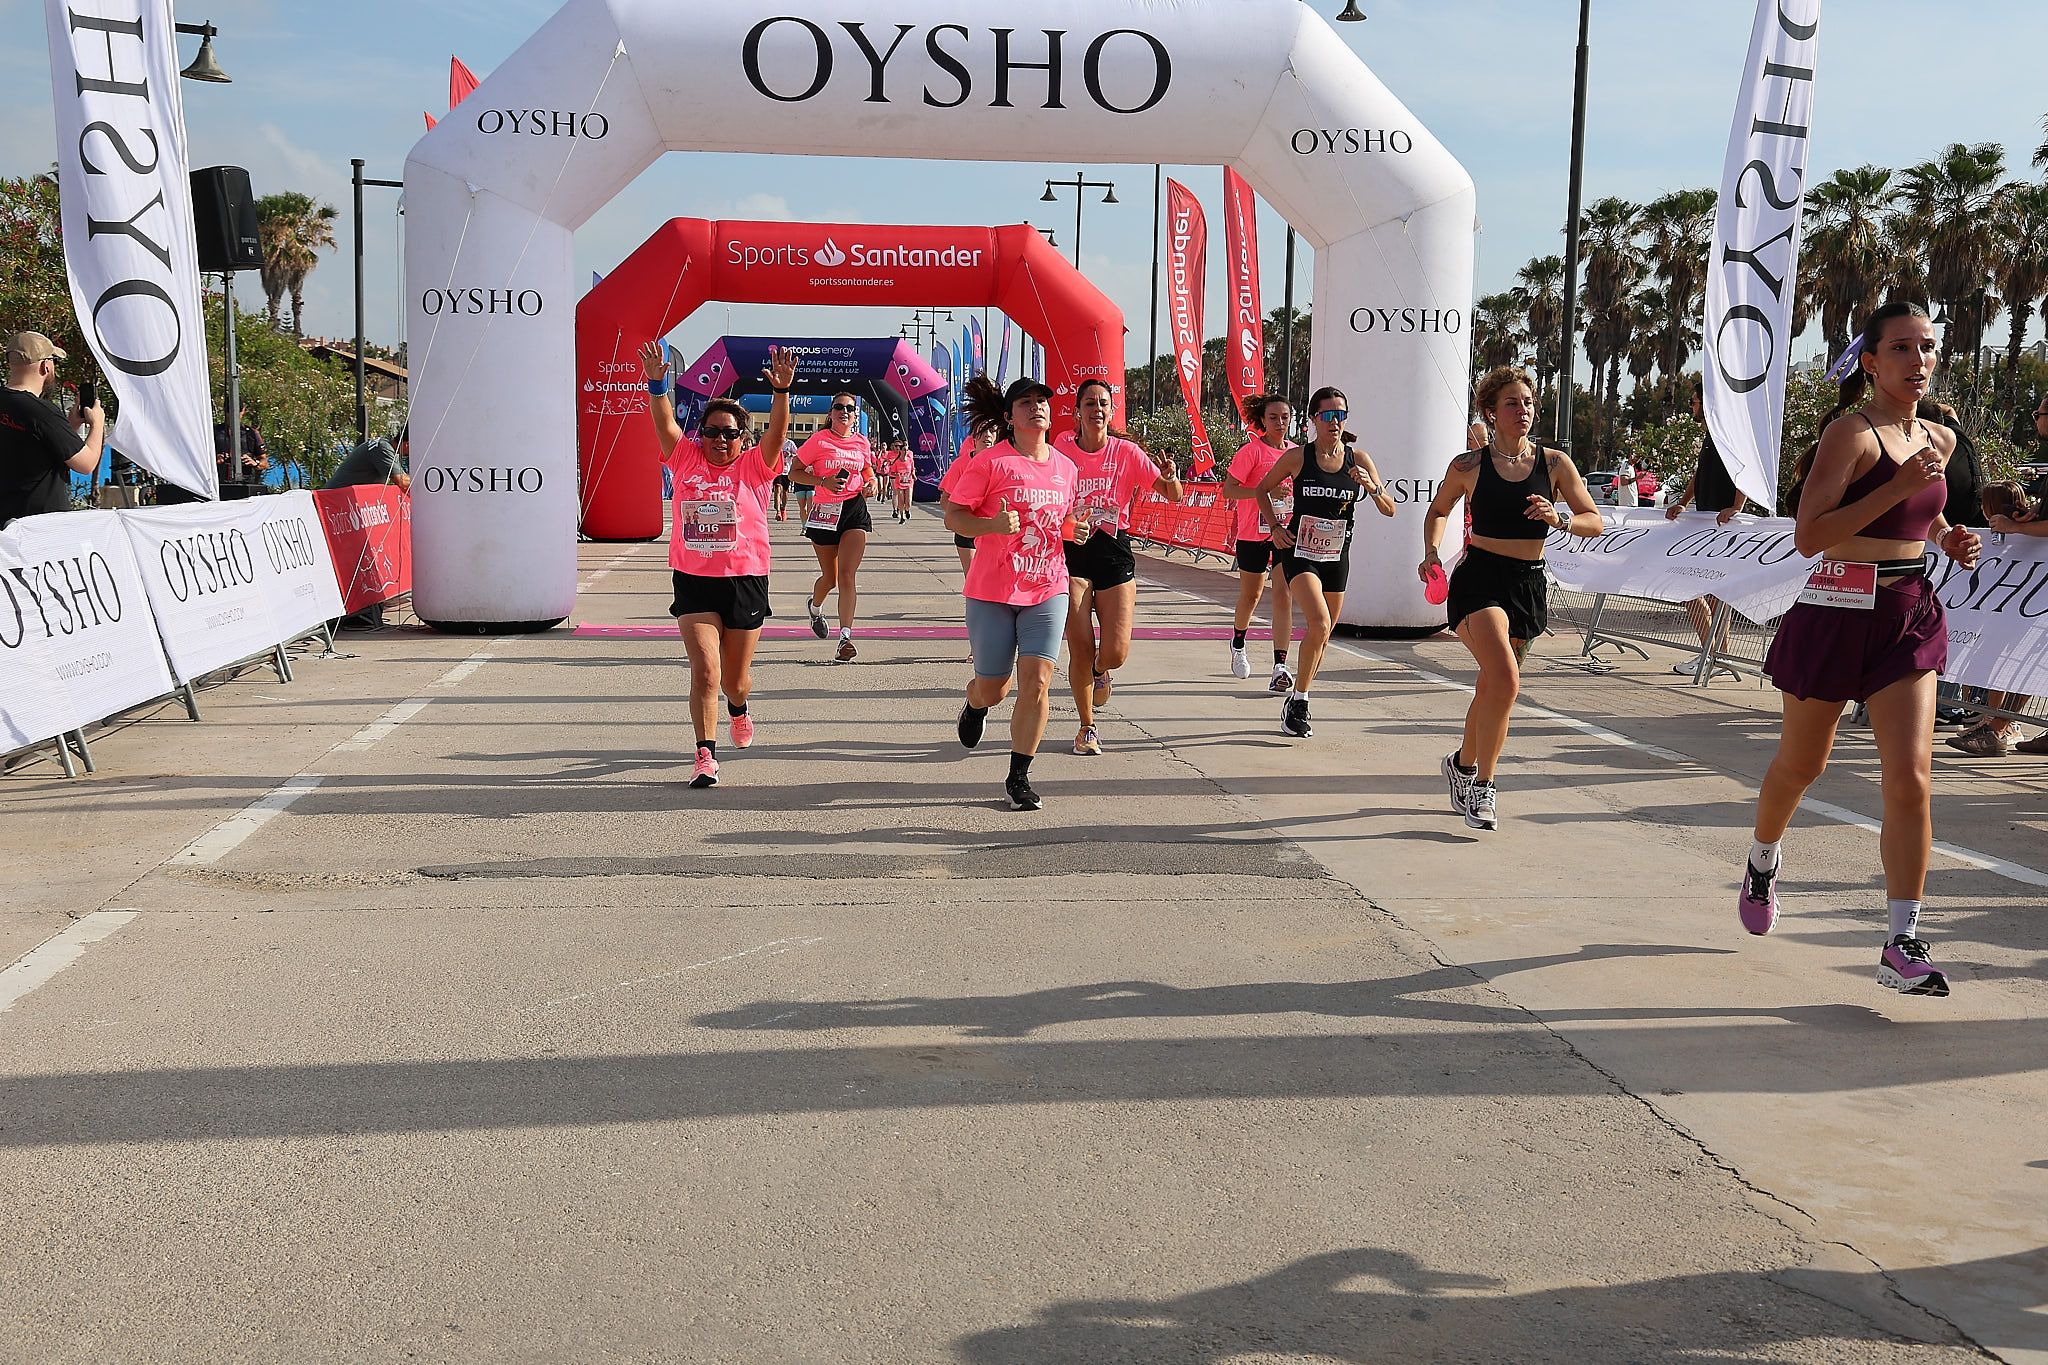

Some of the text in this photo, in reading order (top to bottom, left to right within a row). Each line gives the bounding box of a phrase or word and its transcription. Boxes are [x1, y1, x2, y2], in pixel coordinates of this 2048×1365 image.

[741, 16, 1172, 114] OYSHO
[477, 109, 609, 140] OYSHO
[1291, 128, 1413, 154] OYSHO
[727, 240, 982, 270] Sports Santander
[809, 277, 894, 287] sportssantander.es
[422, 288, 543, 316] OYSHO
[1350, 307, 1461, 334] OYSHO
[821, 347, 855, 357] energy
[598, 361, 636, 375] Sports
[1072, 364, 1109, 377] Sports
[595, 380, 649, 392] Santande
[424, 466, 543, 493] OYSHO
[1014, 489, 1065, 504] CARRERA
[698, 524, 719, 533] 016
[262, 518, 314, 574] OYSHO
[1312, 537, 1331, 547] 016
[161, 529, 254, 602] OYSHO
[1834, 596, 1864, 605] Santander
